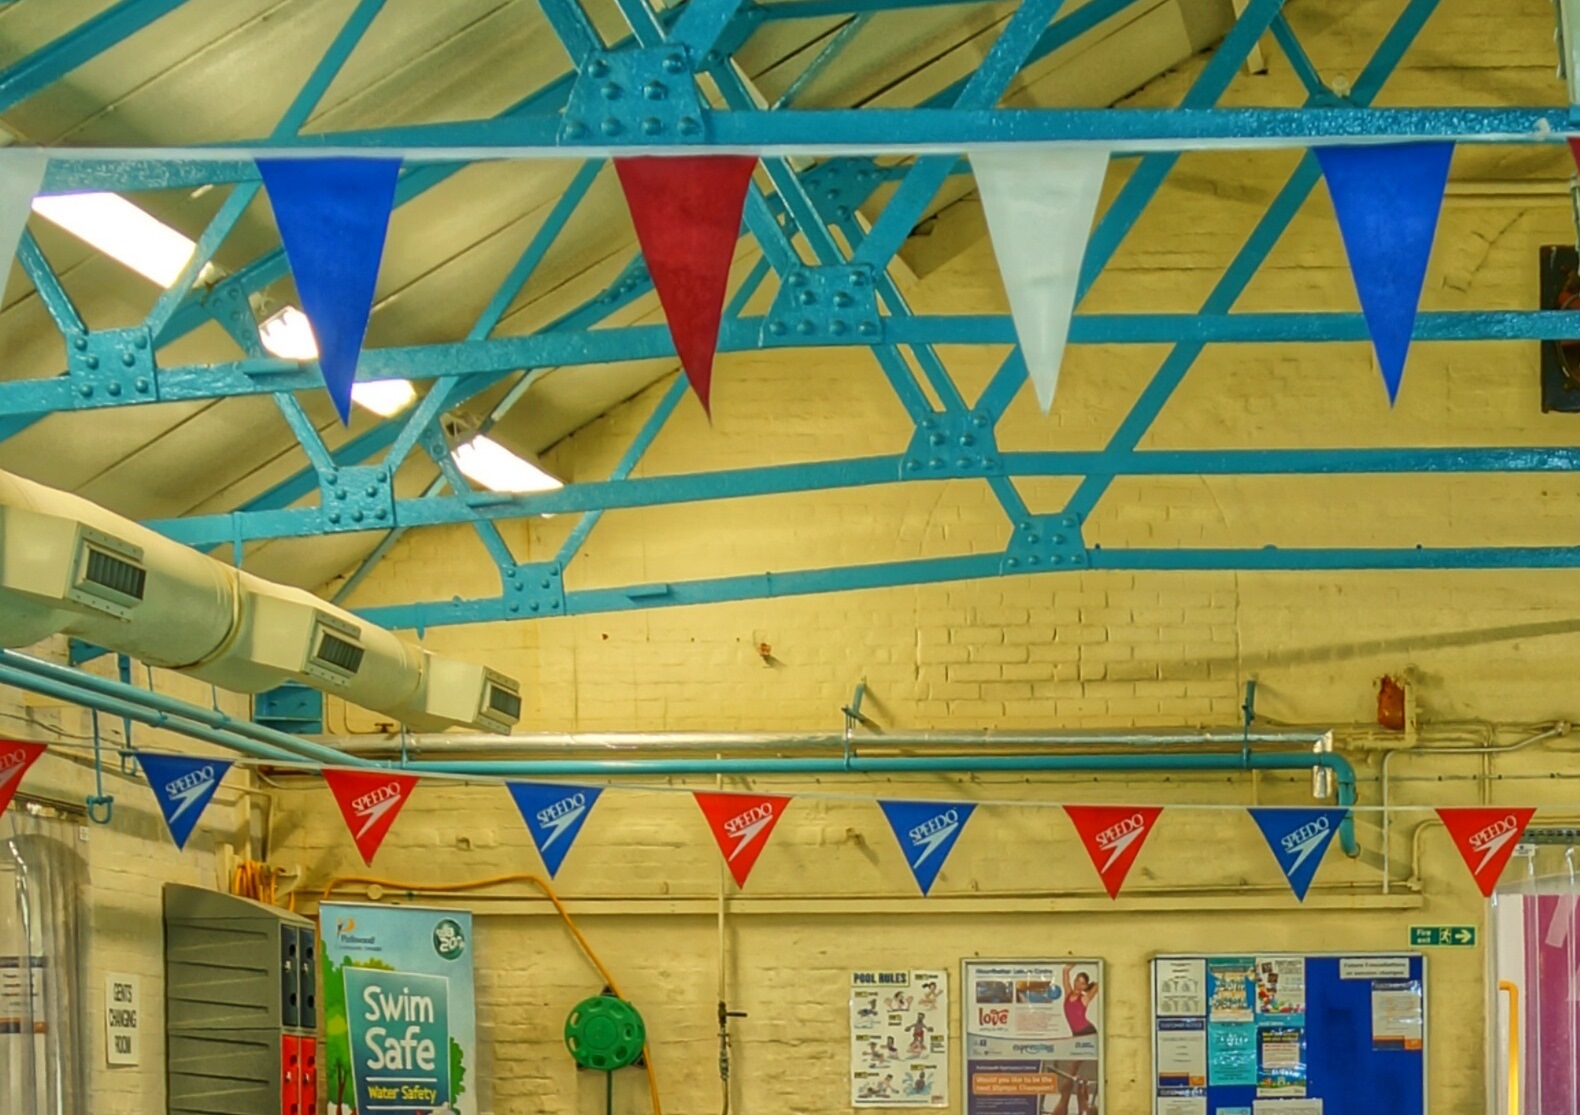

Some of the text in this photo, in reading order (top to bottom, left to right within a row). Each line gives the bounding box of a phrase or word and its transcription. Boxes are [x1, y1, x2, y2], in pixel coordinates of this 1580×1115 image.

[165, 765, 214, 795] SPEEDO
[352, 781, 401, 811] SPEEDO
[537, 793, 585, 823] SPEEDO
[724, 803, 772, 832] SPEEDO
[909, 809, 958, 840] SPEEDO
[1096, 813, 1144, 847] SPEEDO
[1281, 816, 1329, 848] SPEEDO
[1469, 815, 1517, 847] SPEEDO
[853, 972, 877, 984] POOL
[878, 973, 907, 984] RULES
[363, 985, 434, 1023] Swim
[979, 1007, 1009, 1026] love
[365, 1026, 435, 1071] Safe
[367, 1086, 437, 1104] Water Safety
